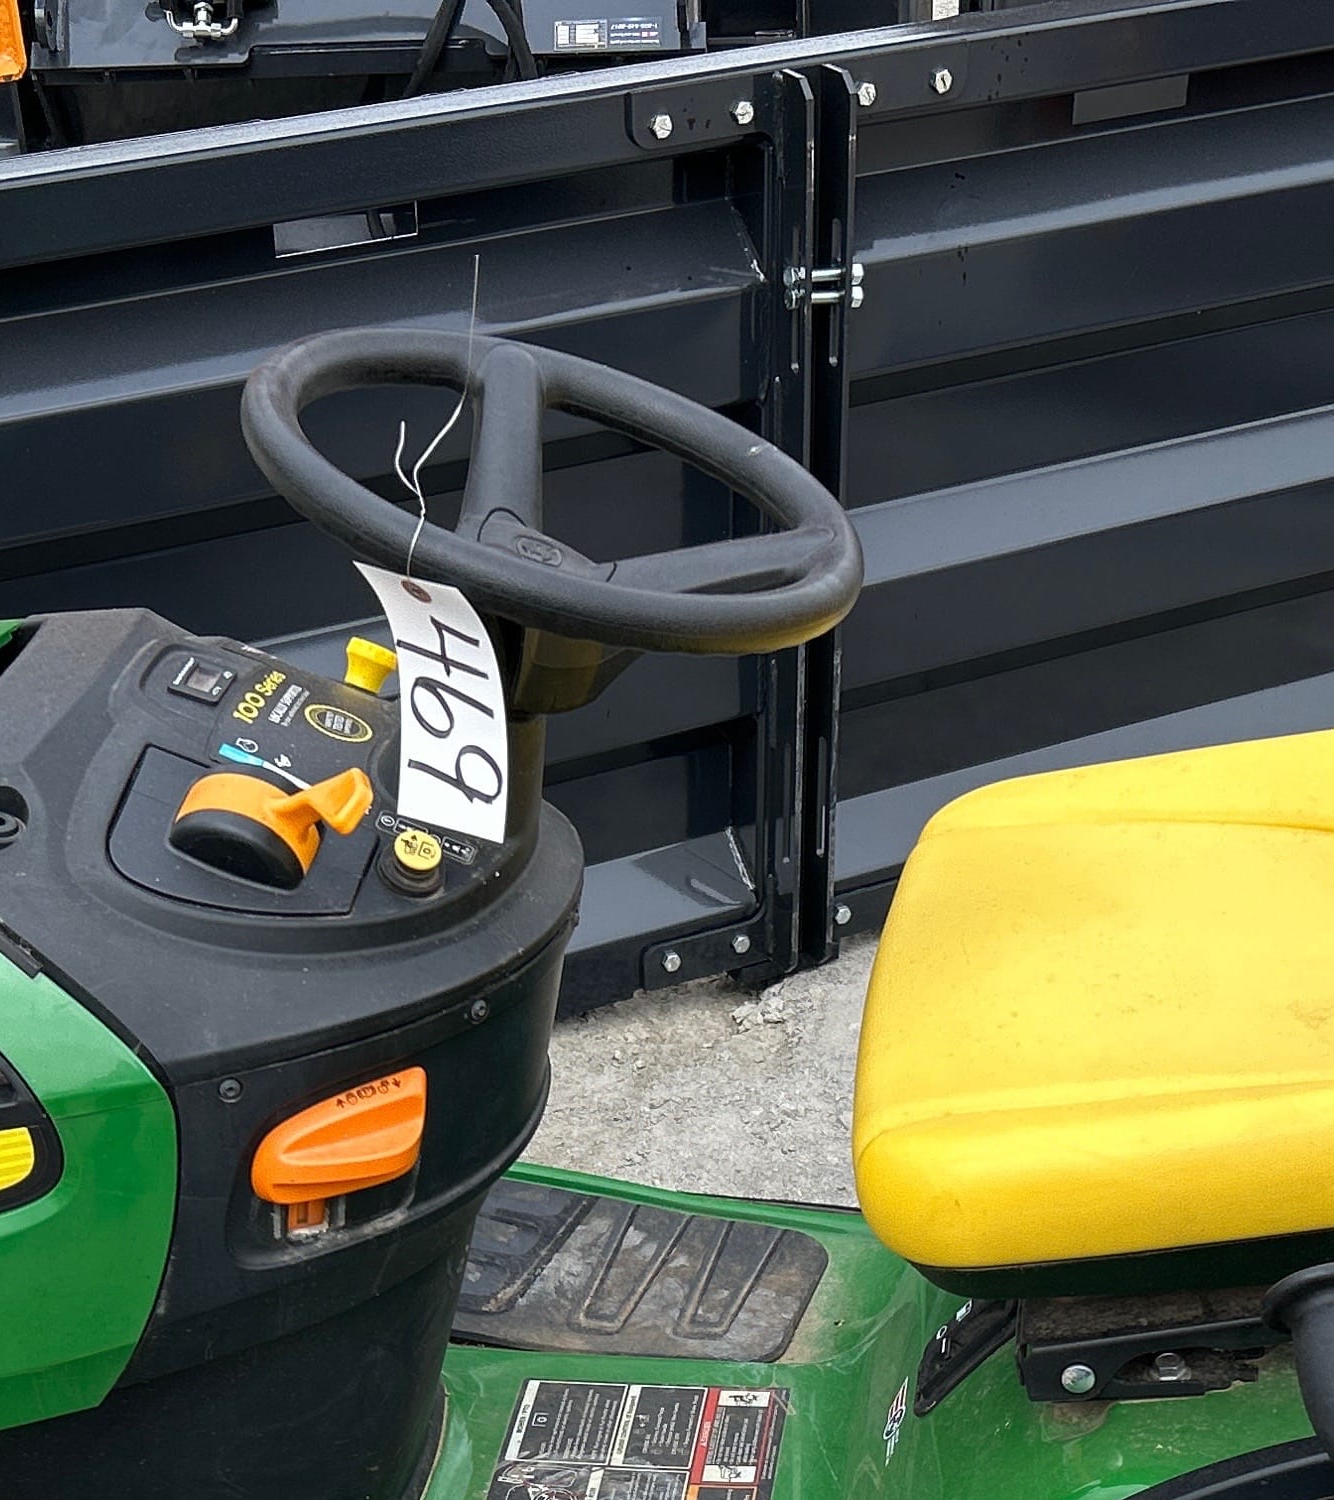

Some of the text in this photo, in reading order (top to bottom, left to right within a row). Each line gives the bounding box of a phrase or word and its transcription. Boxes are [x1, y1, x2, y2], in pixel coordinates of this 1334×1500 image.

[233, 692, 266, 725] 100
[254, 670, 287, 697] Series
[397, 615, 504, 806] 469
